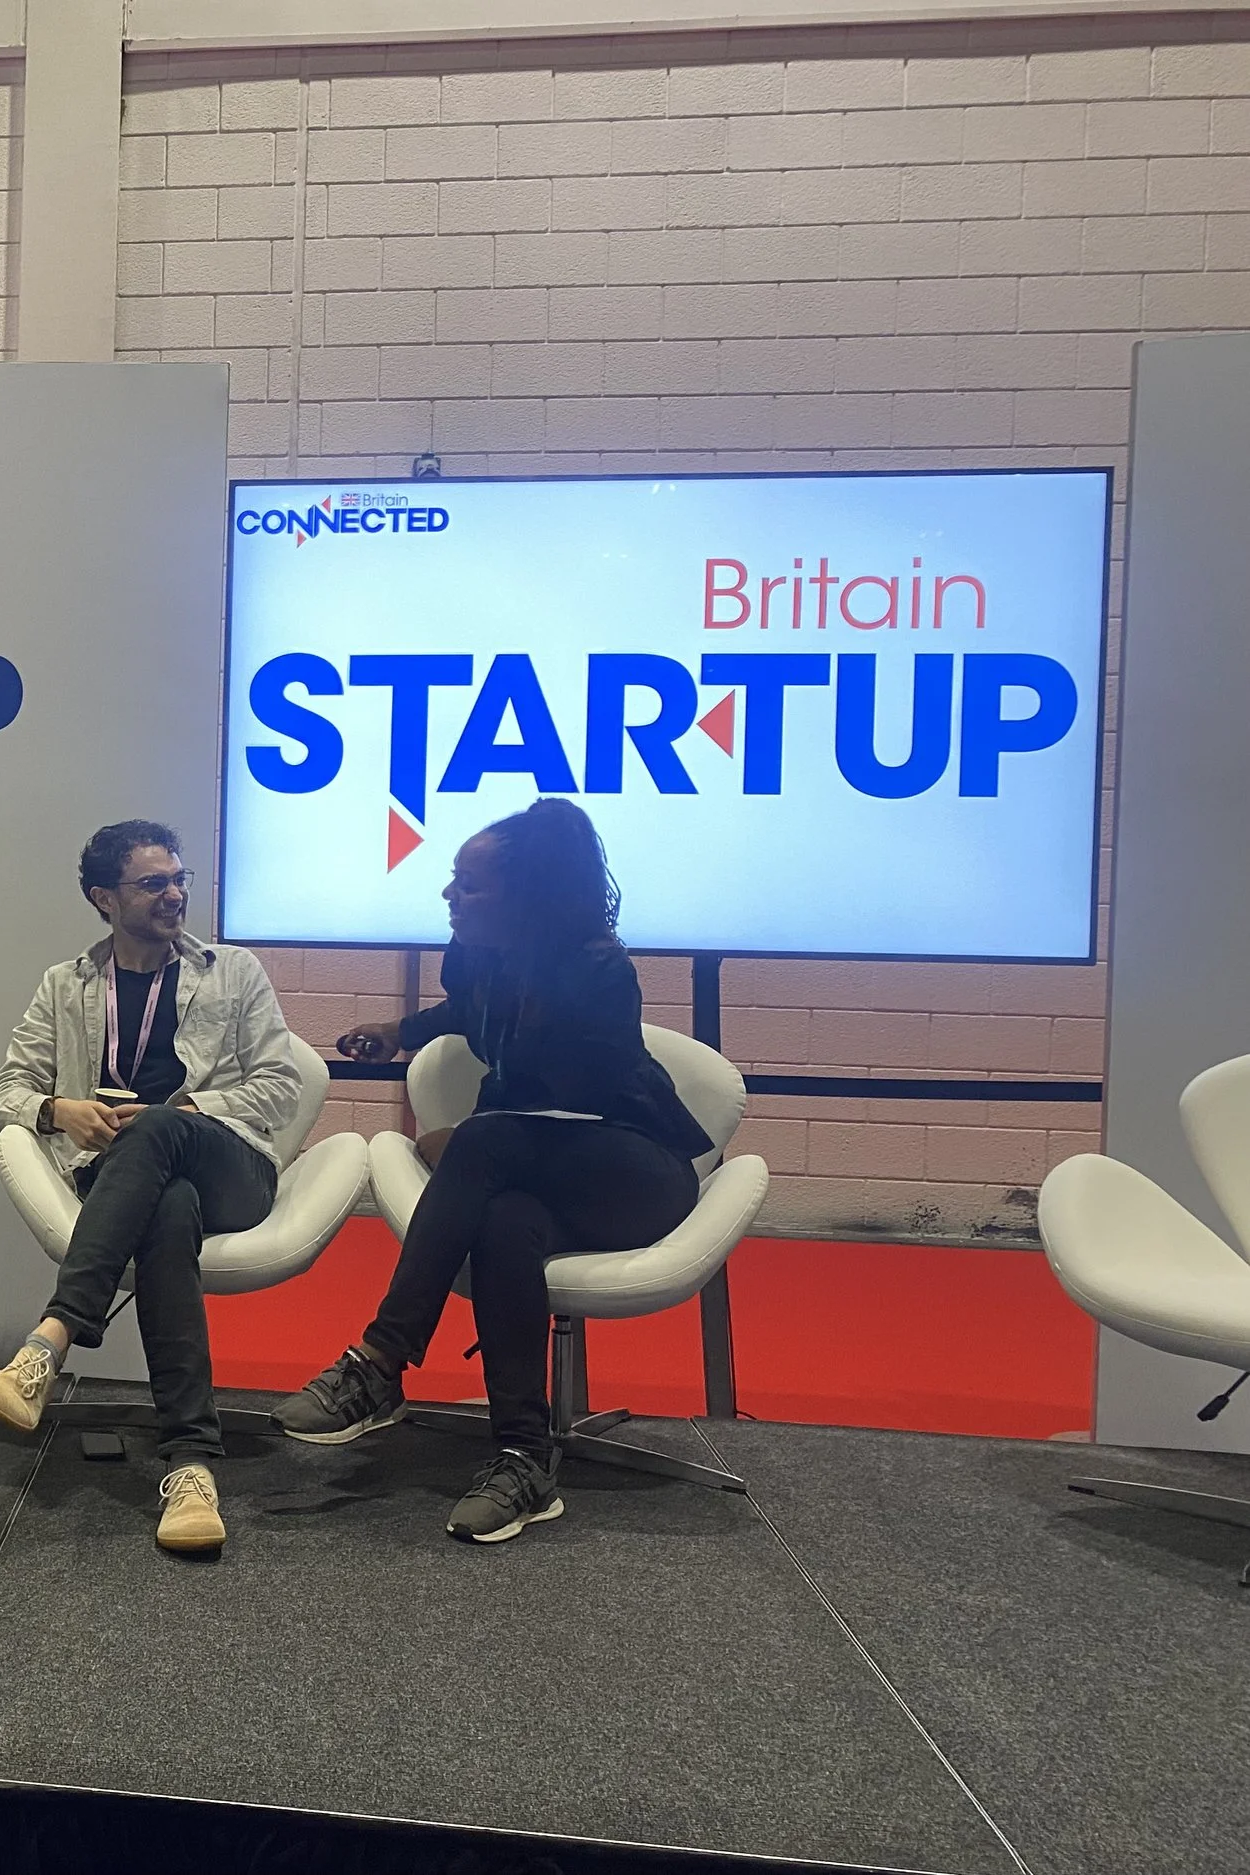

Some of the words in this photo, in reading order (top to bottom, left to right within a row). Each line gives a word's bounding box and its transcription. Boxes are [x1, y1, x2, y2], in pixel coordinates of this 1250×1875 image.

[236, 504, 450, 539] CONNECTED
[362, 493, 409, 507] Britain
[703, 556, 988, 632] Britain
[244, 652, 1079, 826] STARTUP
